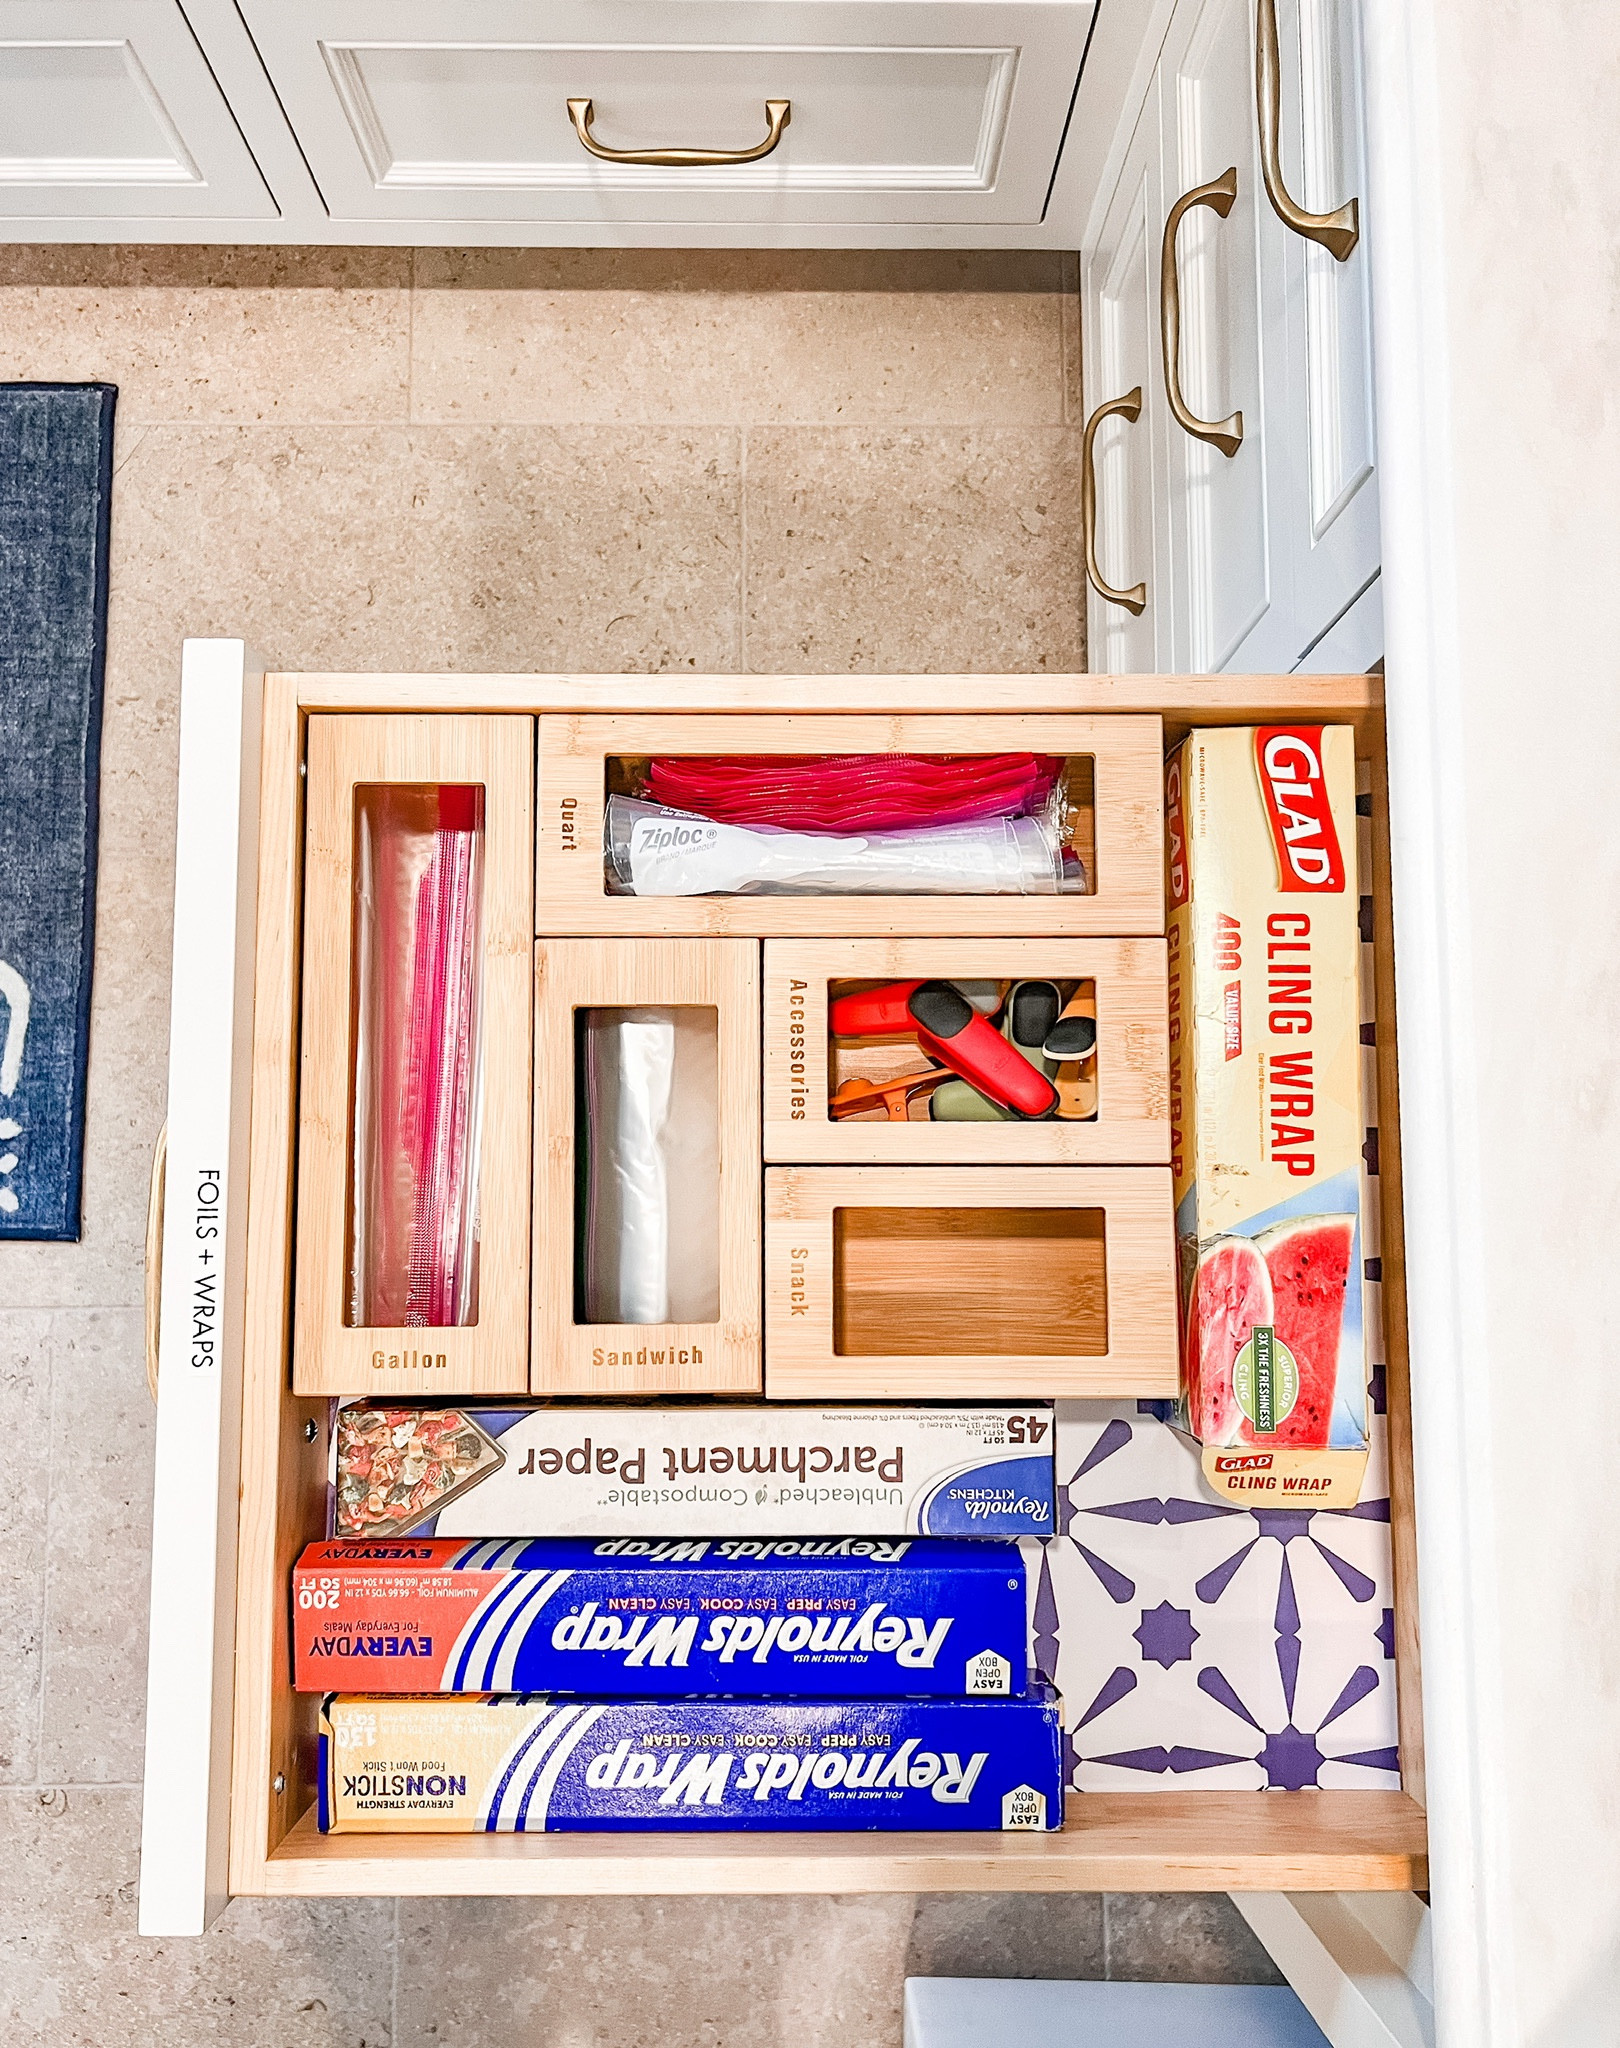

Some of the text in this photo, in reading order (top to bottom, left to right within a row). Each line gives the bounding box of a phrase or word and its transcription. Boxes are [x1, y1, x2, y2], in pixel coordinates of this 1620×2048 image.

[1264, 735, 1331, 885] GLAD
[560, 798, 578, 851] Quart
[1167, 761, 1185, 898] GLAD
[639, 826, 703, 854] Ziploc
[1212, 912, 1242, 971] 400
[1225, 989, 1240, 1050] VALUE SIZE
[790, 979, 810, 1122] Accessories
[1267, 913, 1315, 1177] CLING WRAP
[191, 1169, 220, 1368] FOILS + WRAPS
[791, 1247, 810, 1317] Snack
[1258, 1332, 1269, 1346] 3X
[372, 1350, 447, 1369] Gallon
[592, 1344, 704, 1367] Sandwich
[1258, 1348, 1270, 1367] THE
[1238, 1363, 1250, 1400] CLING
[1278, 1355, 1293, 1408] SUPERIOR
[822, 1414, 852, 1422] bleaching
[890, 1414, 901, 1422] and
[902, 1414, 919, 1422] fibers
[920, 1414, 956, 1422] unbleached
[1006, 1416, 1048, 1444] 45
[983, 1436, 992, 1444] FT
[518, 1438, 904, 1485] Parchment Paper
[1220, 1457, 1270, 1469] GLAD
[1227, 1475, 1332, 1491] CLING WRAP
[964, 1497, 1050, 1522] Reynolds
[318, 1548, 433, 1559] EVERYDAY
[593, 1537, 912, 1563] Reynolds Wrap
[299, 1577, 340, 1589] SQ FT
[432, 1577, 452, 1586] 18.58
[344, 1588, 354, 1597] IN
[355, 1588, 364, 1597] 12
[371, 1588, 386, 1597] YDS
[416, 1588, 434, 1597] FOIL
[436, 1588, 479, 1597] ALUMINUM
[299, 1589, 340, 1610] 200
[660, 1598, 690, 1610] EASY
[746, 1598, 777, 1610] EASY
[825, 1598, 856, 1610] EASY
[324, 1620, 419, 1633] For Everyday Meals
[551, 1602, 955, 1669] Reynolds Wrap
[309, 1636, 433, 1657] EVERYDAY
[793, 1654, 868, 1663] FOIL MADE IN USA
[978, 1656, 998, 1667] BOX
[975, 1668, 1001, 1678] OPEN
[973, 1680, 1003, 1689] EASY
[694, 1734, 724, 1747] EASY
[780, 1734, 812, 1747] EASY
[861, 1734, 891, 1747] EASY
[362, 1761, 446, 1772] Food Won't Stick
[585, 1738, 990, 1805] Reynolds Wrap
[342, 1775, 466, 1796] NONSTICK
[828, 1790, 904, 1800] FOIL MADE IN USA
[1014, 1792, 1034, 1802] BOX
[356, 1800, 454, 1809] EVERYDAY STRENGTH
[1011, 1803, 1037, 1813] OPEN
[1008, 1814, 1039, 1825] EASY
